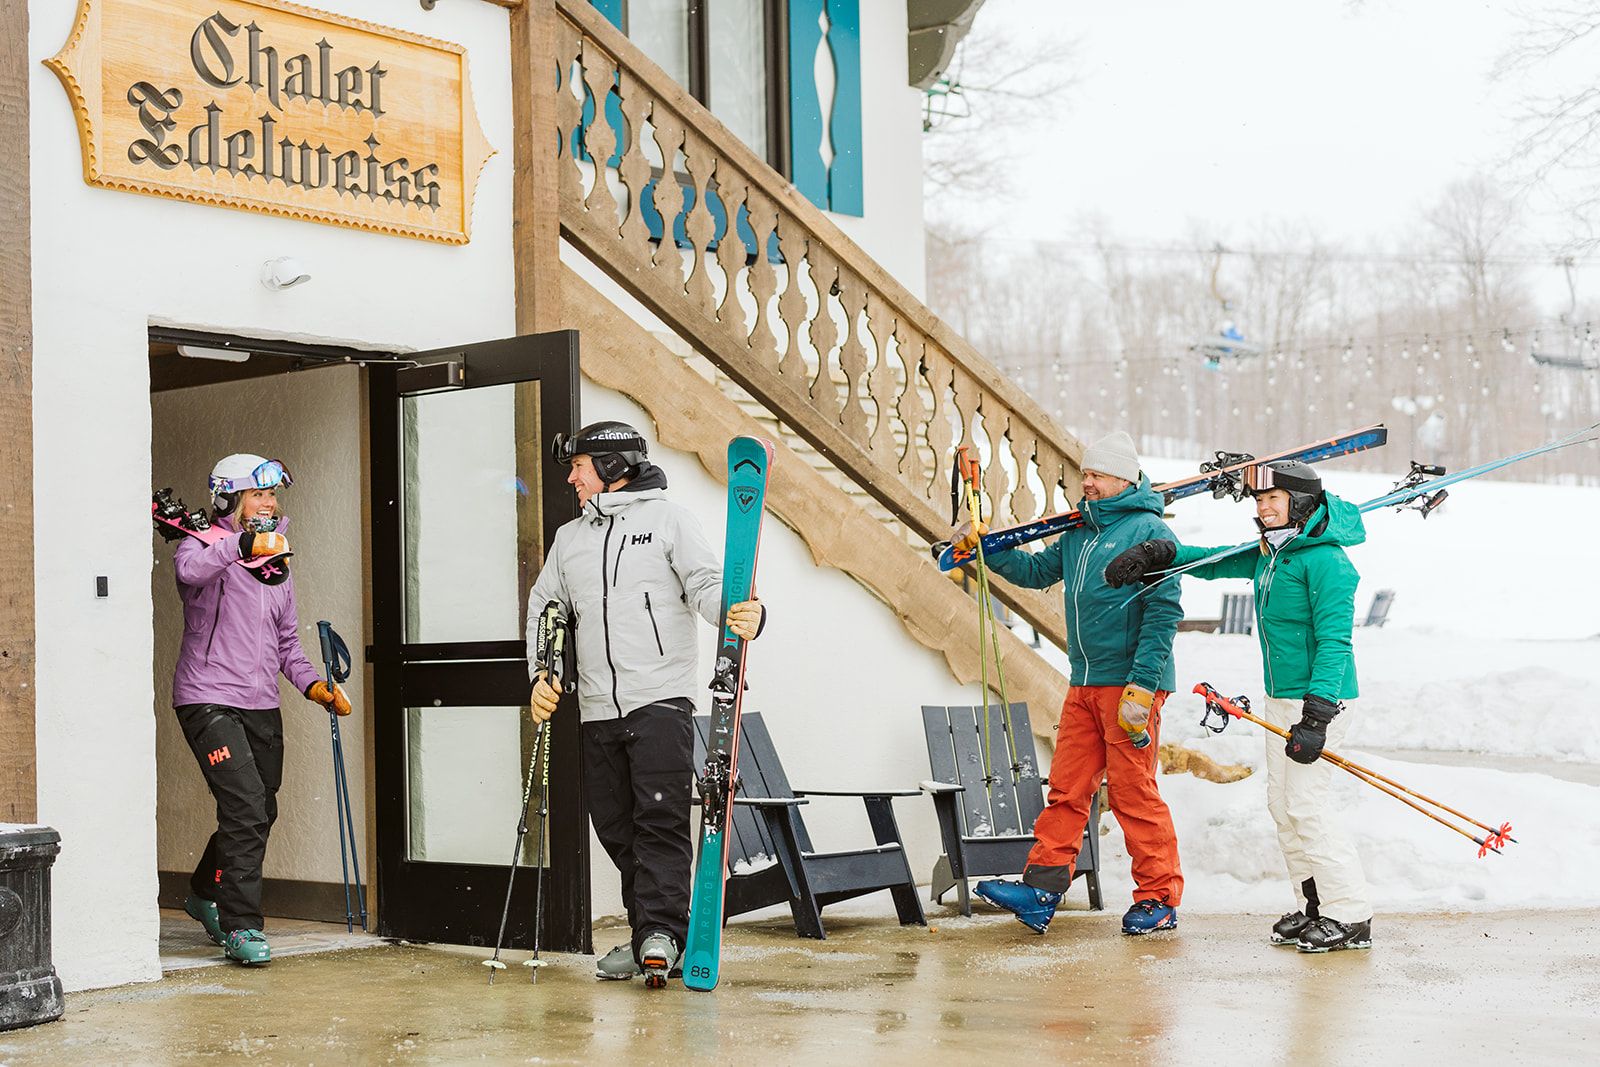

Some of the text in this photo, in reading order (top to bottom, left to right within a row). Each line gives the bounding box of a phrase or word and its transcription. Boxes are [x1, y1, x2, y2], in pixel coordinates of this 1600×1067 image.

[190, 11, 388, 119] Chalet
[127, 81, 441, 212] Edelweiss
[631, 532, 652, 545] HH
[207, 745, 231, 766] HH
[690, 965, 711, 979] 88
